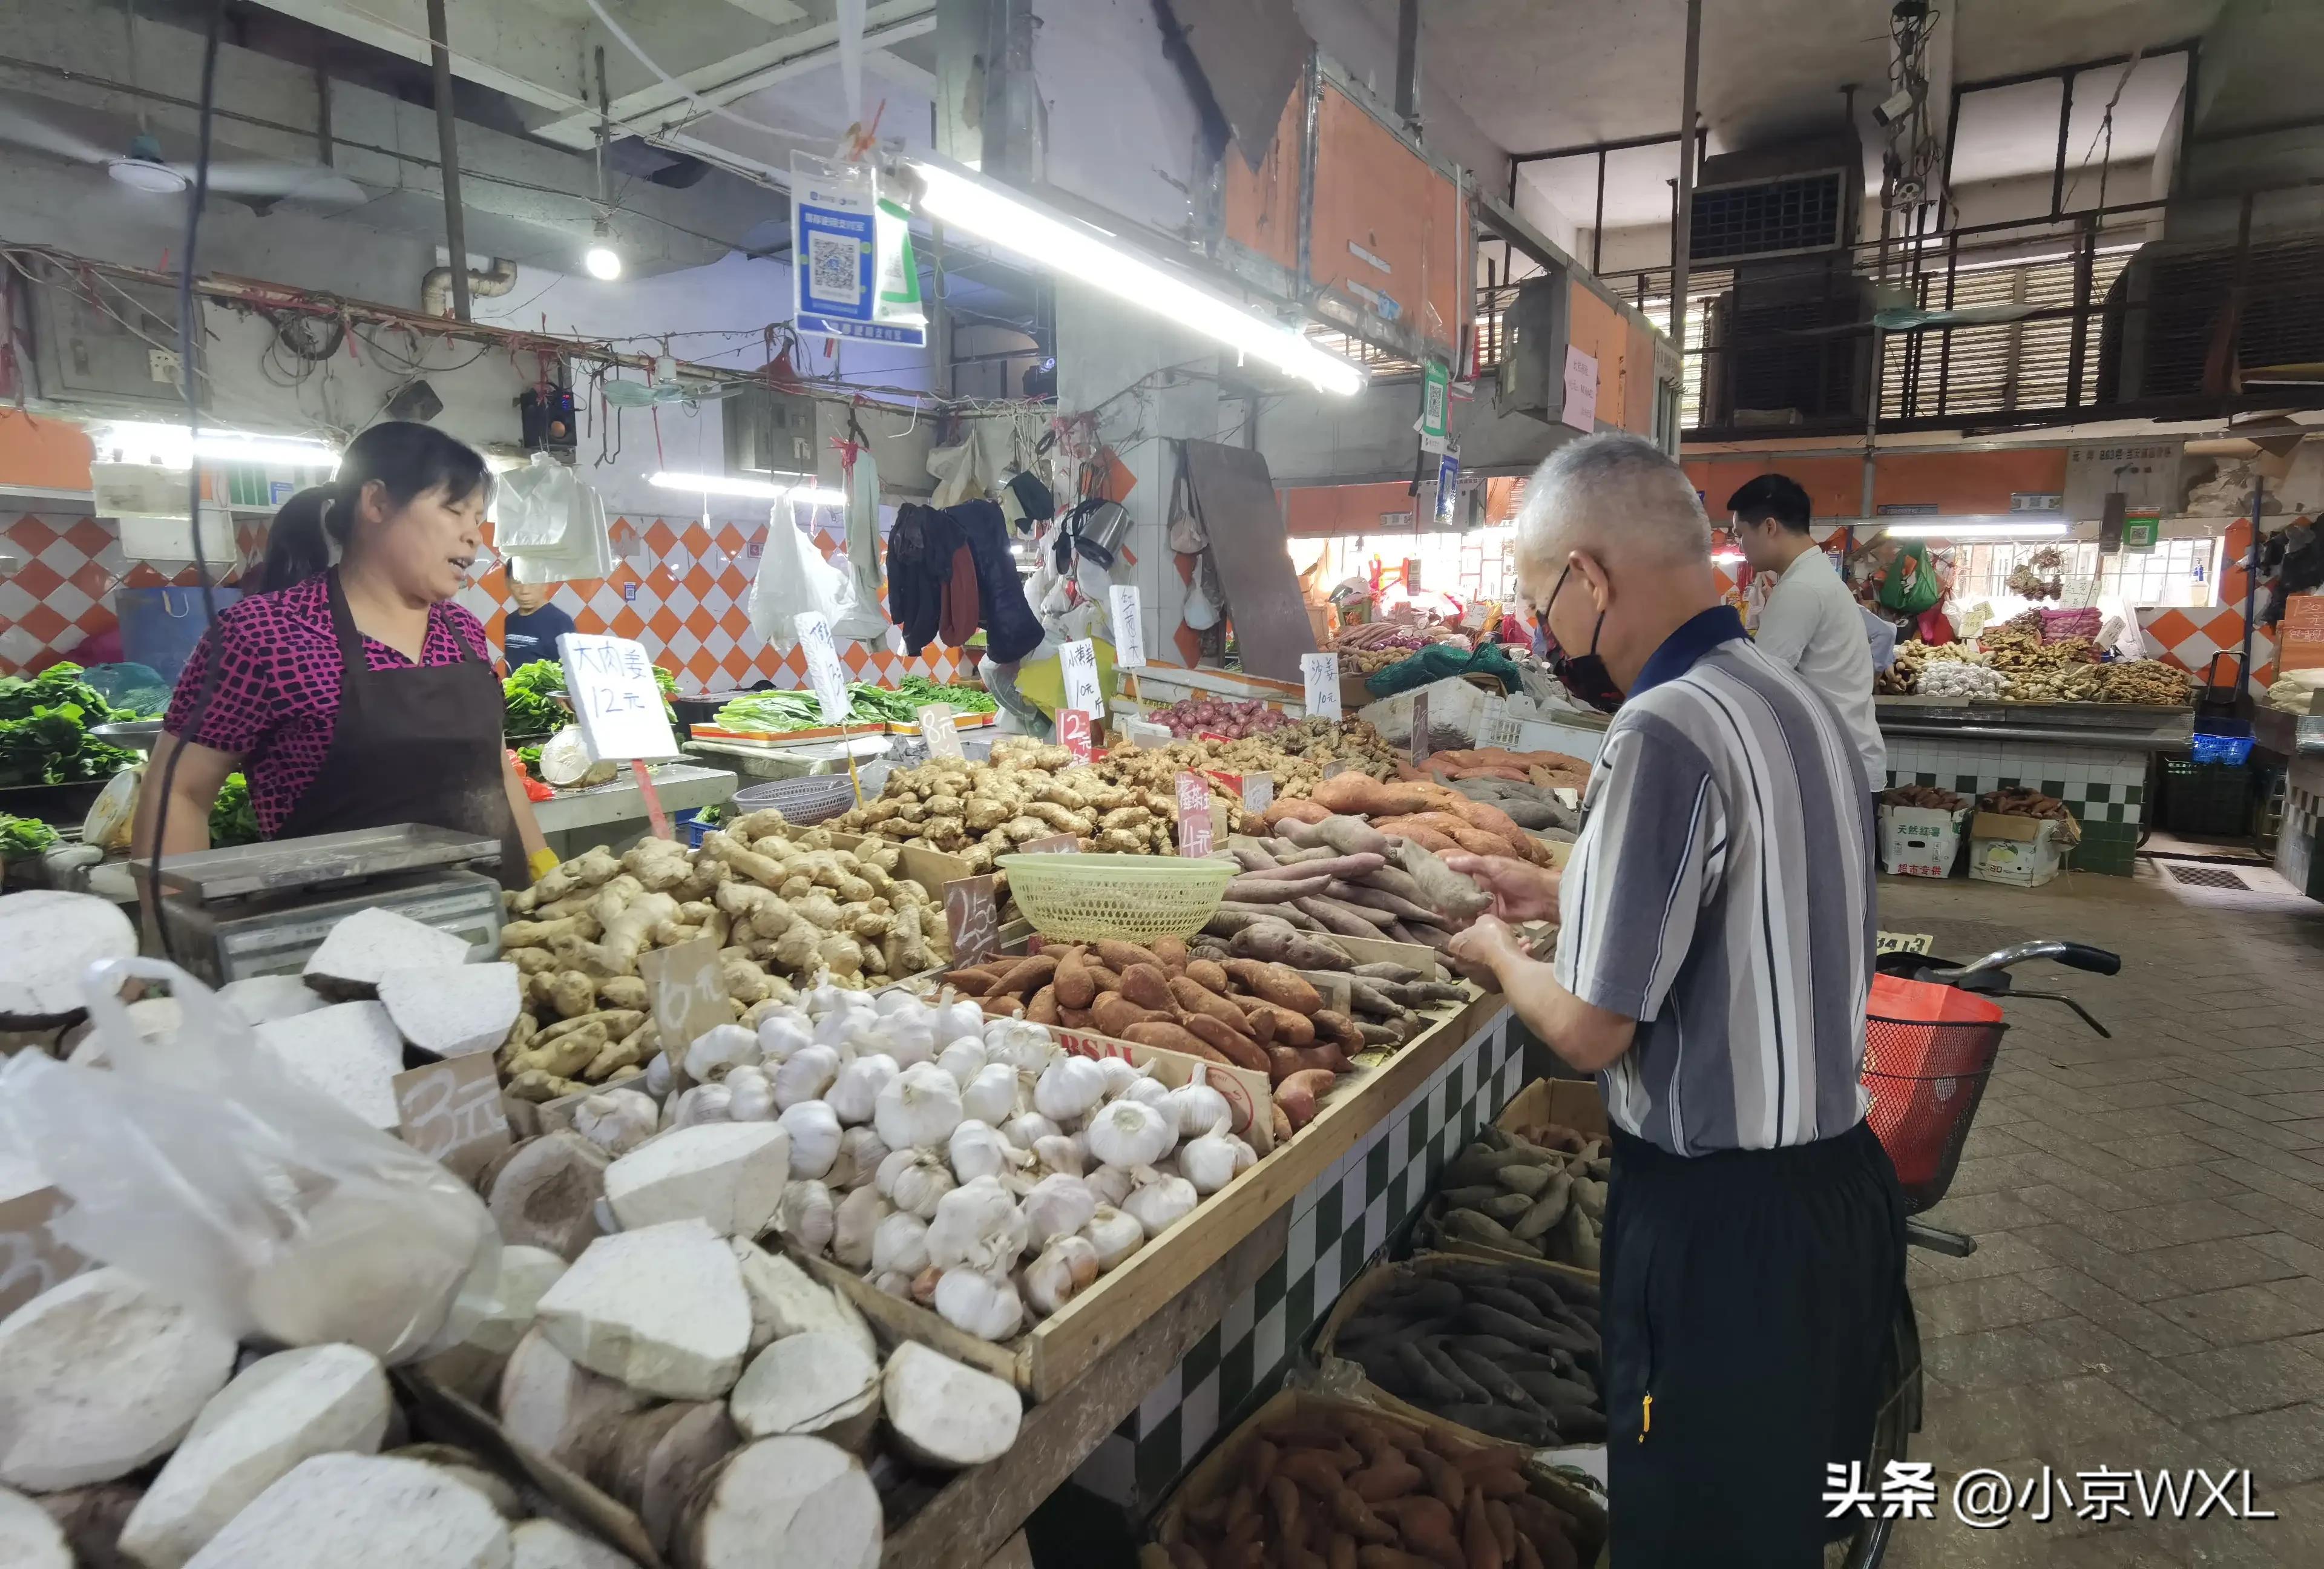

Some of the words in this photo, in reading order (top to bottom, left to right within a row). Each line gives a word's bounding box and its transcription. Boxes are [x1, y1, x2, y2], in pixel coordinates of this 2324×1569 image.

[573, 640, 646, 680] 大肉姜
[1068, 643, 1095, 668] 小黄姜
[1310, 656, 1338, 685] 沙姜
[592, 686, 646, 719] 12元
[1076, 679, 1095, 708] 10元
[1316, 691, 1337, 715] 10元
[922, 709, 957, 744] 8元
[1060, 711, 1092, 751] 12元
[1182, 820, 1213, 858] 4元
[1897, 824, 1940, 837] 天然红薯
[1897, 863, 1942, 876] 超市专供
[401, 1068, 509, 1161] 3元
